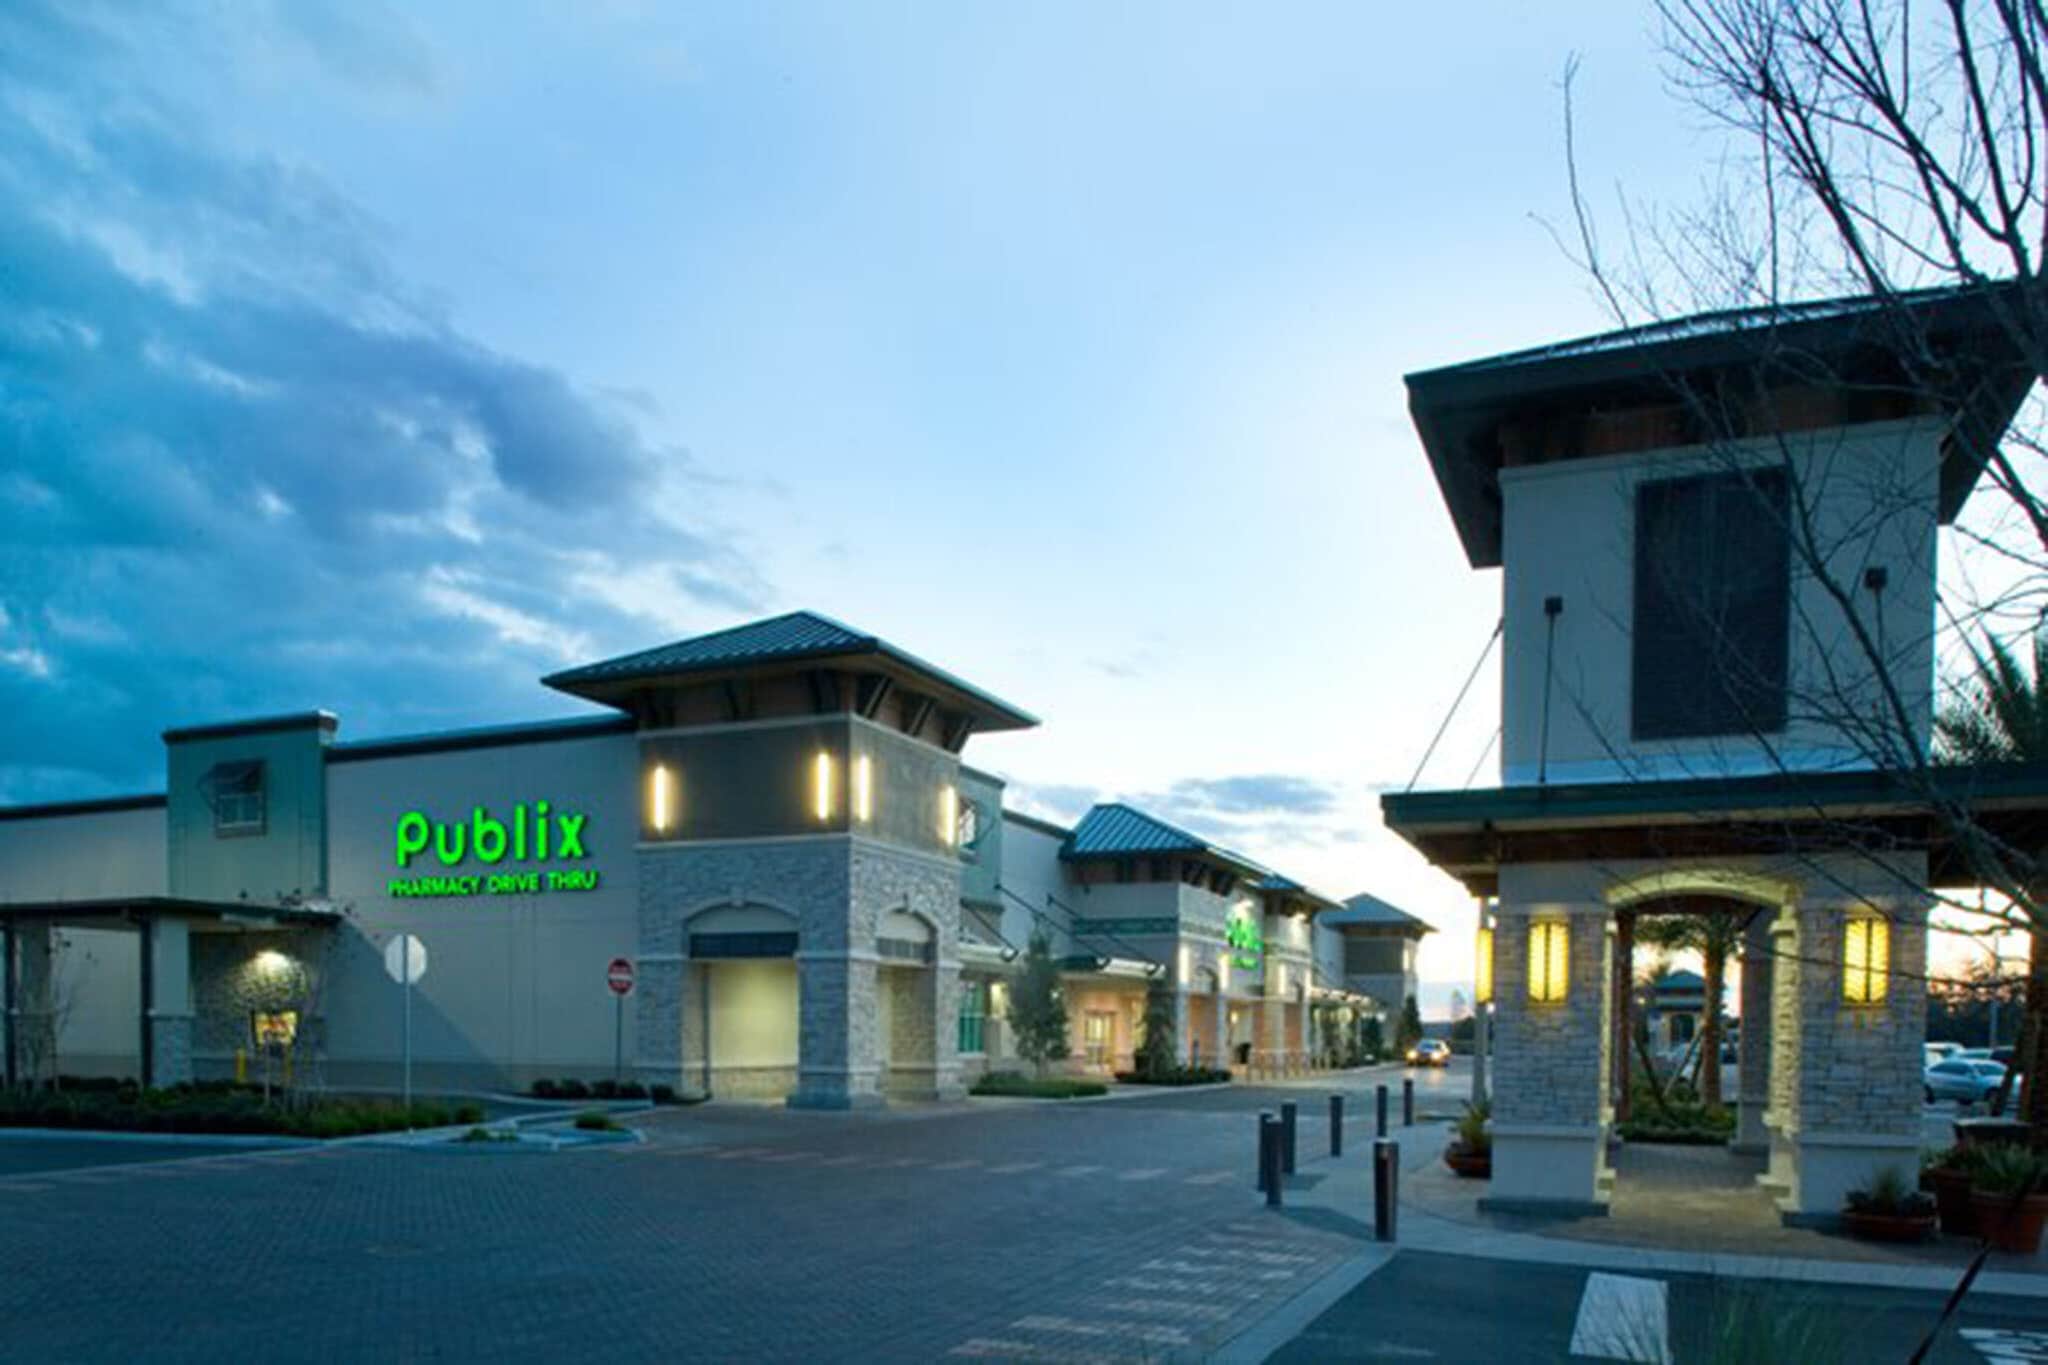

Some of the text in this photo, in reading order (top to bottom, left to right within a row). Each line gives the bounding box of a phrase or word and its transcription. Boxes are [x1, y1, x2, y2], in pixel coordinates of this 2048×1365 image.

[396, 800, 586, 867] Publix
[389, 870, 598, 896] PHARMACY DRIVE THRU
